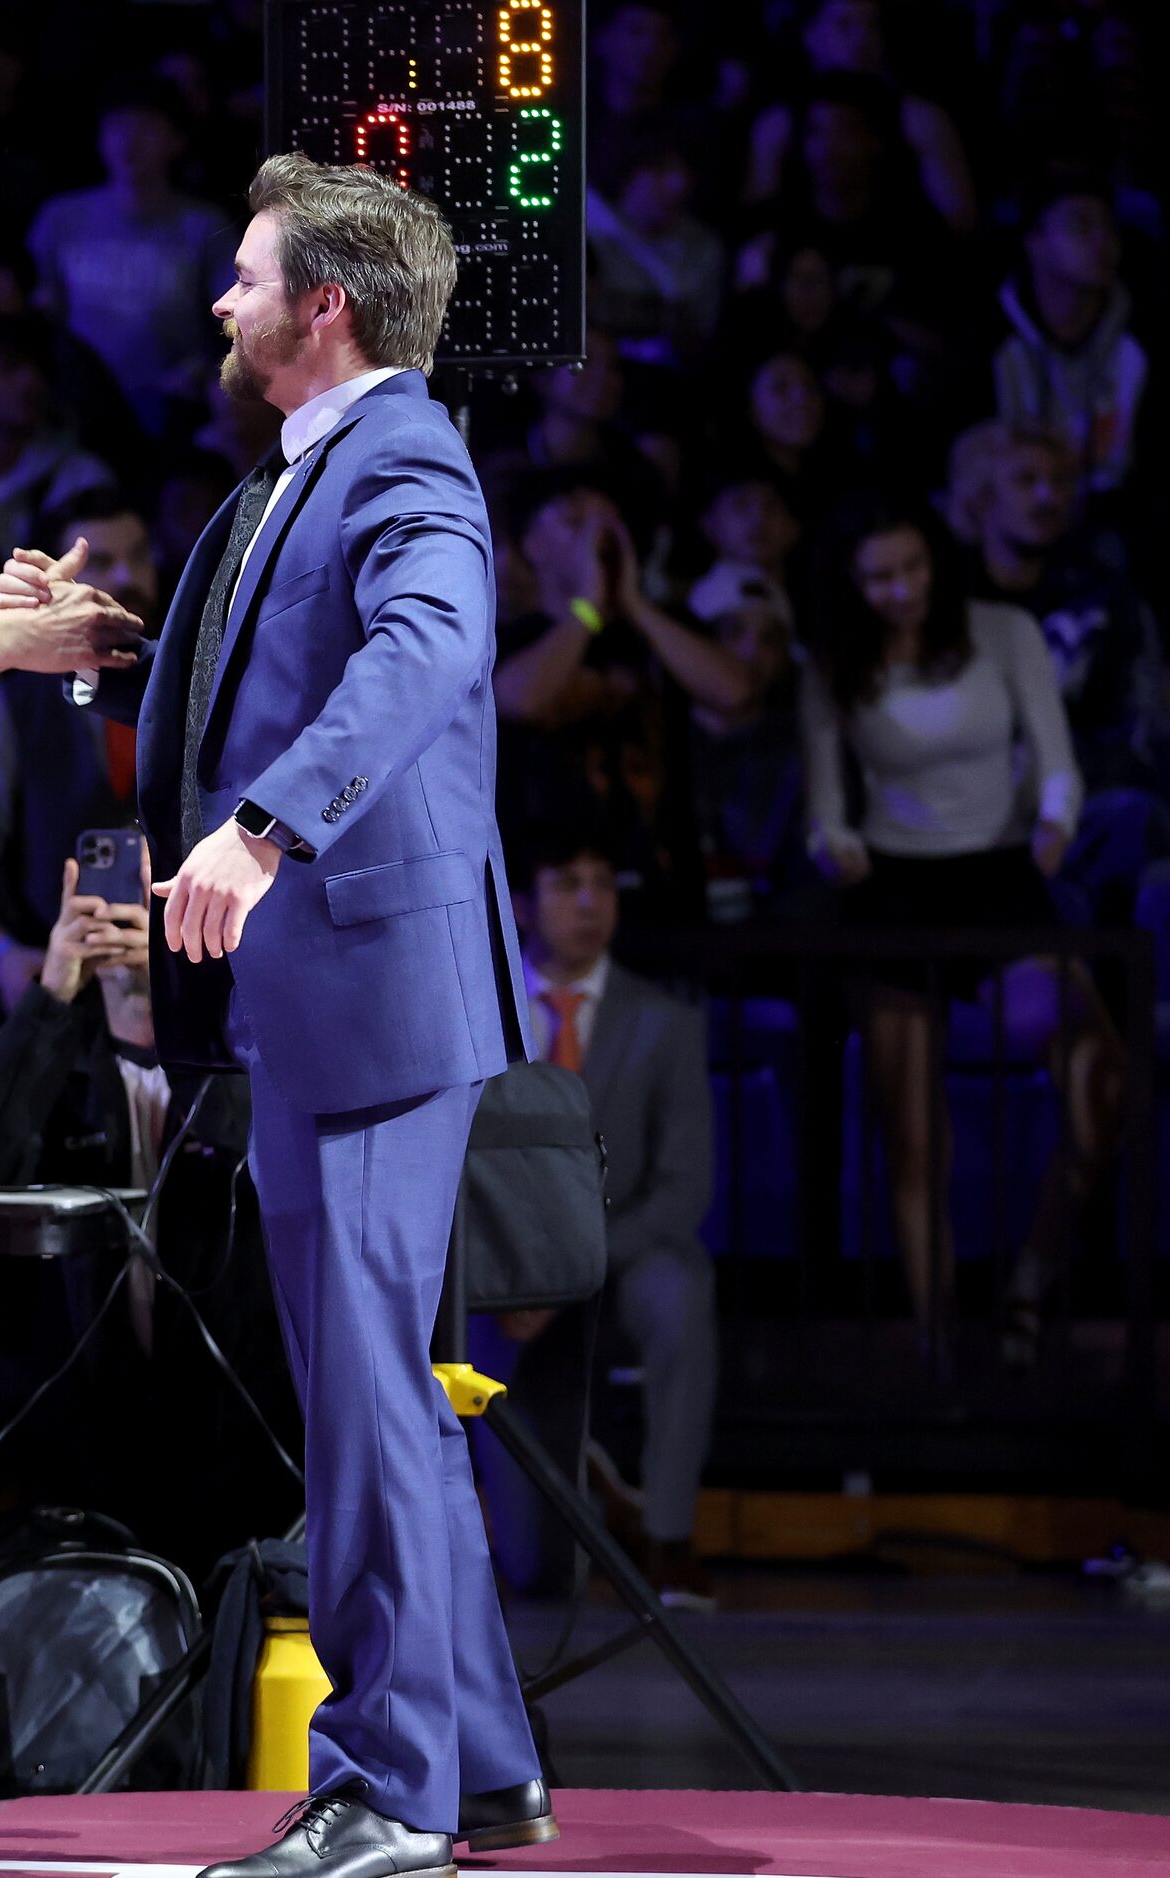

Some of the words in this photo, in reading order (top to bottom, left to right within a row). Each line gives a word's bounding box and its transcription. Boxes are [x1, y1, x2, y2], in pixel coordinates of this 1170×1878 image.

[498, 0, 553, 97] 8
[376, 102, 413, 113] S/N:
[508, 108, 562, 207] 2
[454, 242, 509, 255] ng.com
